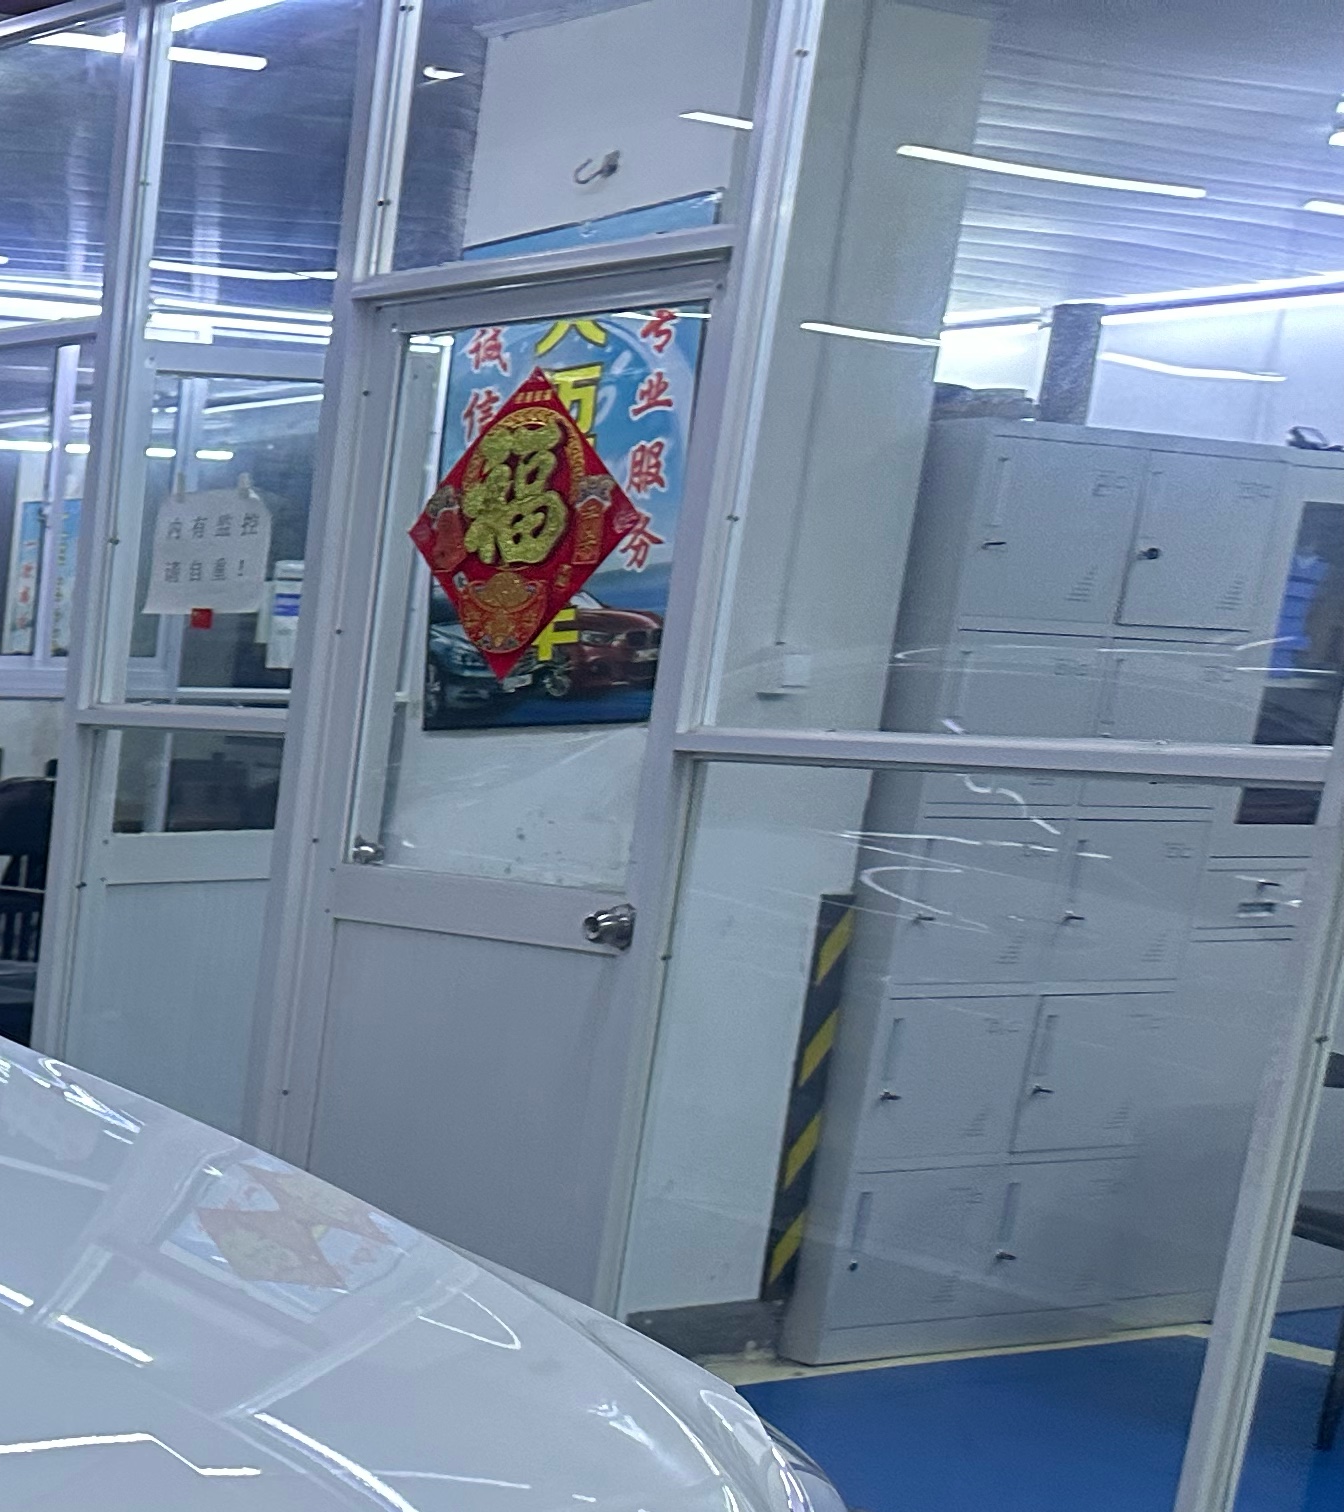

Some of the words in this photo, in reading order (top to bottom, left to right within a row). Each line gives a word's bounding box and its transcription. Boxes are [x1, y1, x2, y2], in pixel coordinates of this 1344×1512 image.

[463, 418, 569, 565] 福
[619, 309, 678, 570] 专业服务
